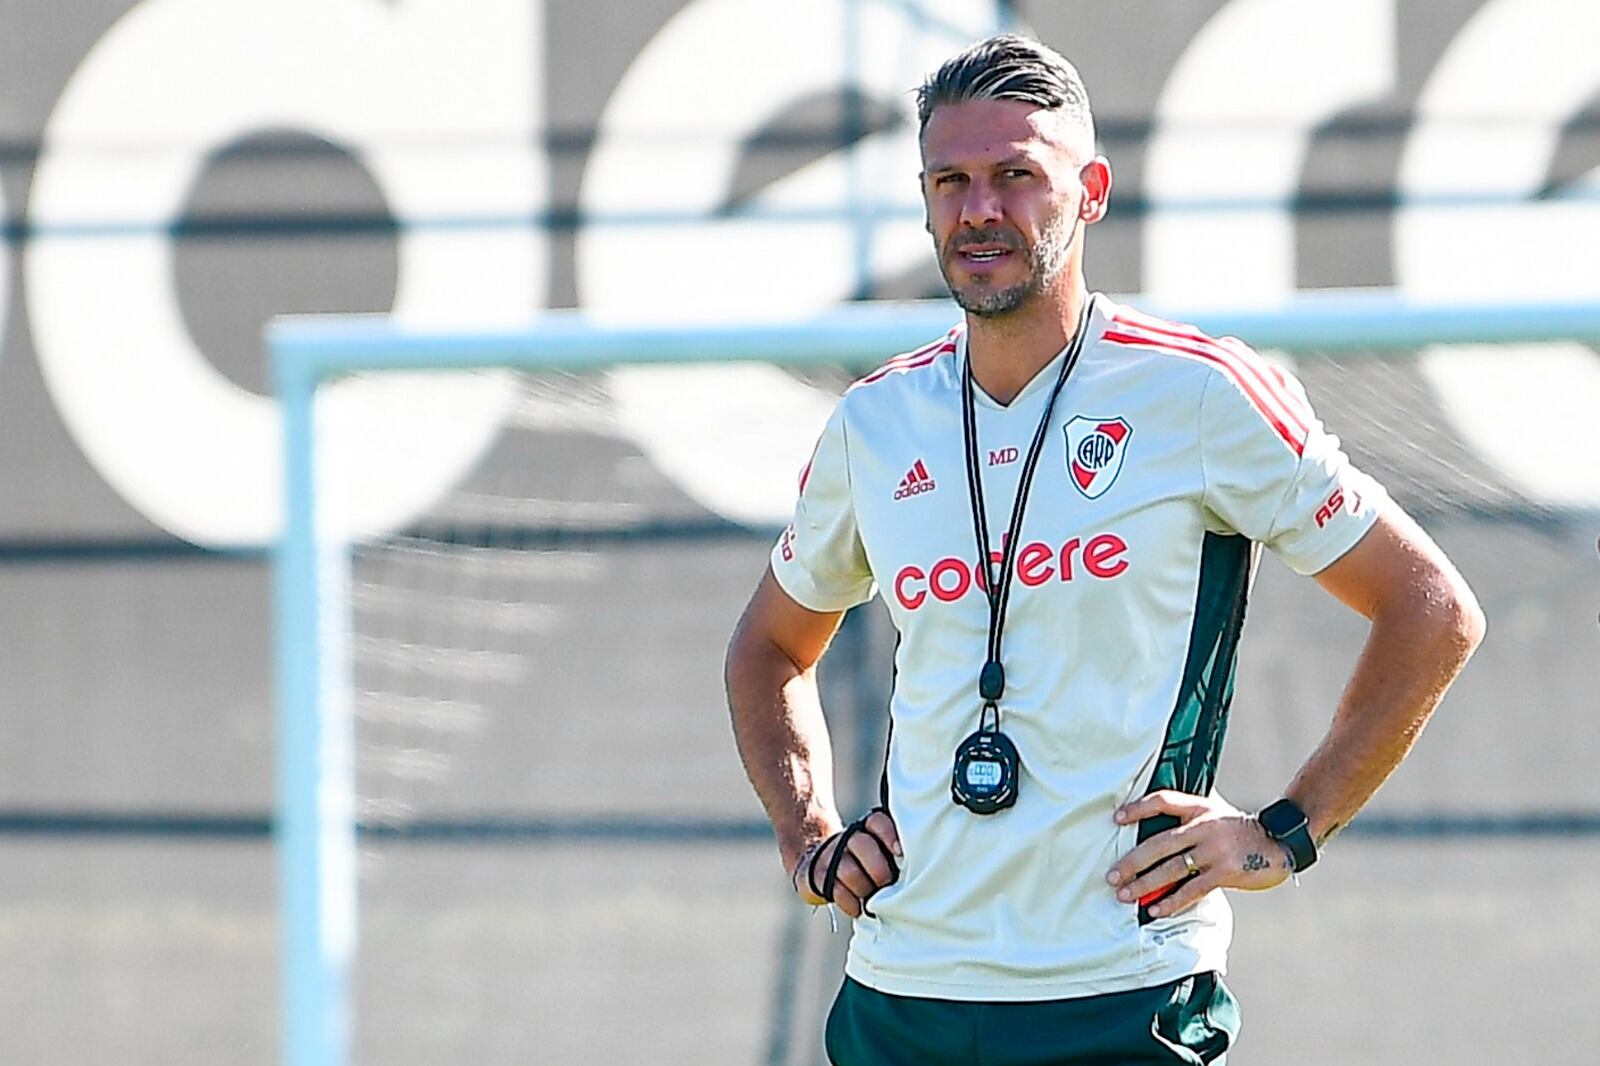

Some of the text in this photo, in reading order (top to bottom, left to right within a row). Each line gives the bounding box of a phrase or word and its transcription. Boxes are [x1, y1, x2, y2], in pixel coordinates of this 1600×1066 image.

[989, 448, 1019, 466] MD
[894, 479, 936, 501] adidas
[895, 533, 1130, 611] codere
